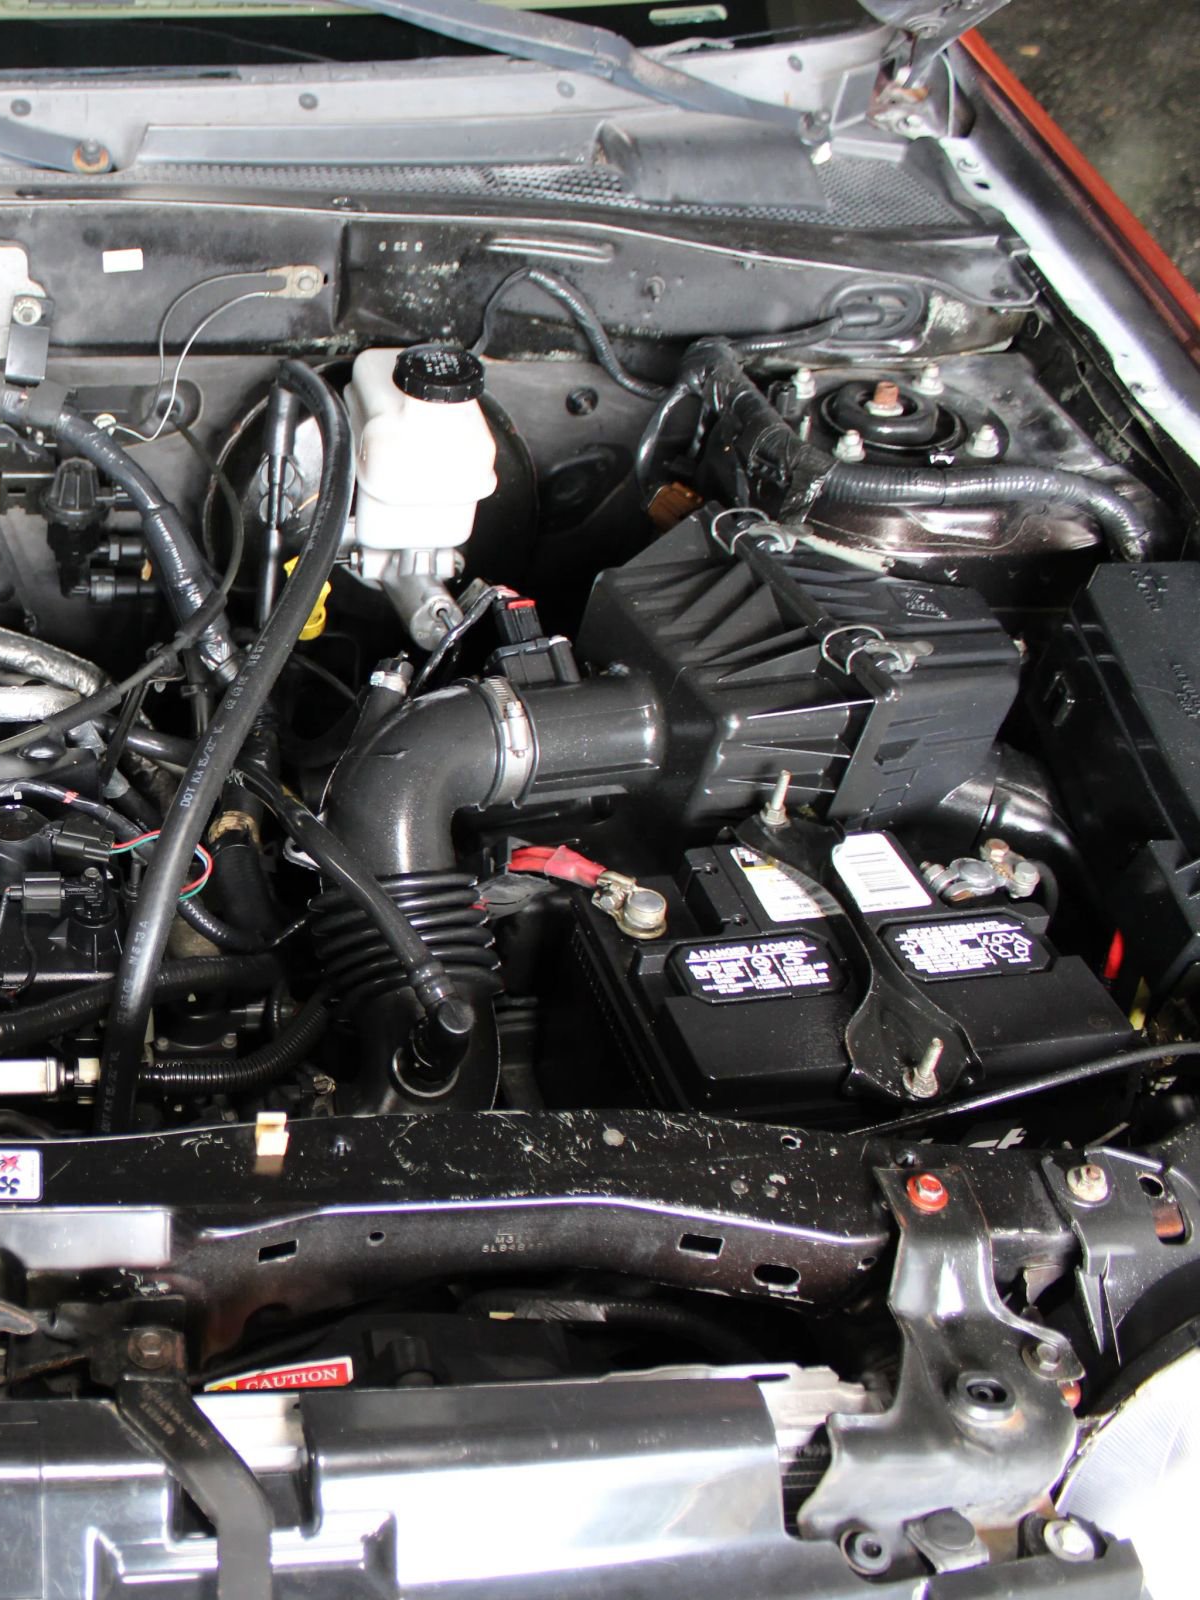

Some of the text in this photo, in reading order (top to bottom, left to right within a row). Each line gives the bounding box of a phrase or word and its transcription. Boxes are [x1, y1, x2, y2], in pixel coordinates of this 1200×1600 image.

[180, 787, 196, 808] DOT
[700, 946, 751, 958] DANGER
[760, 940, 806, 952] POISON
